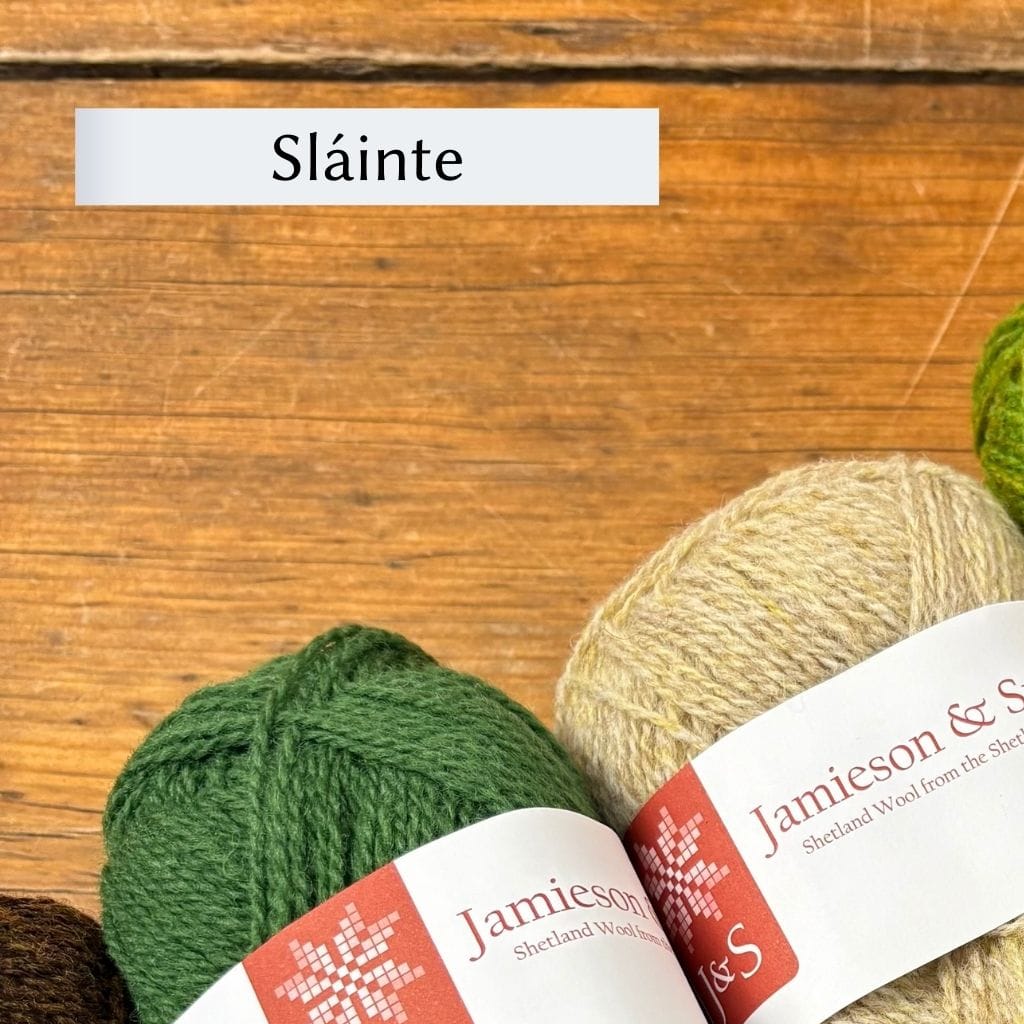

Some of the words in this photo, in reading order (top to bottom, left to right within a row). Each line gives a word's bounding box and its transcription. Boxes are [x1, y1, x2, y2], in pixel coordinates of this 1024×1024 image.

[749, 731, 946, 858] Jamieson
[947, 697, 996, 737] &
[802, 808, 875, 855] Shetland
[872, 784, 921, 816] Wool
[920, 768, 961, 795] from
[961, 754, 989, 773] the
[456, 878, 649, 962] Jamieson
[513, 921, 595, 961] Shetland
[594, 921, 638, 938] Wool
